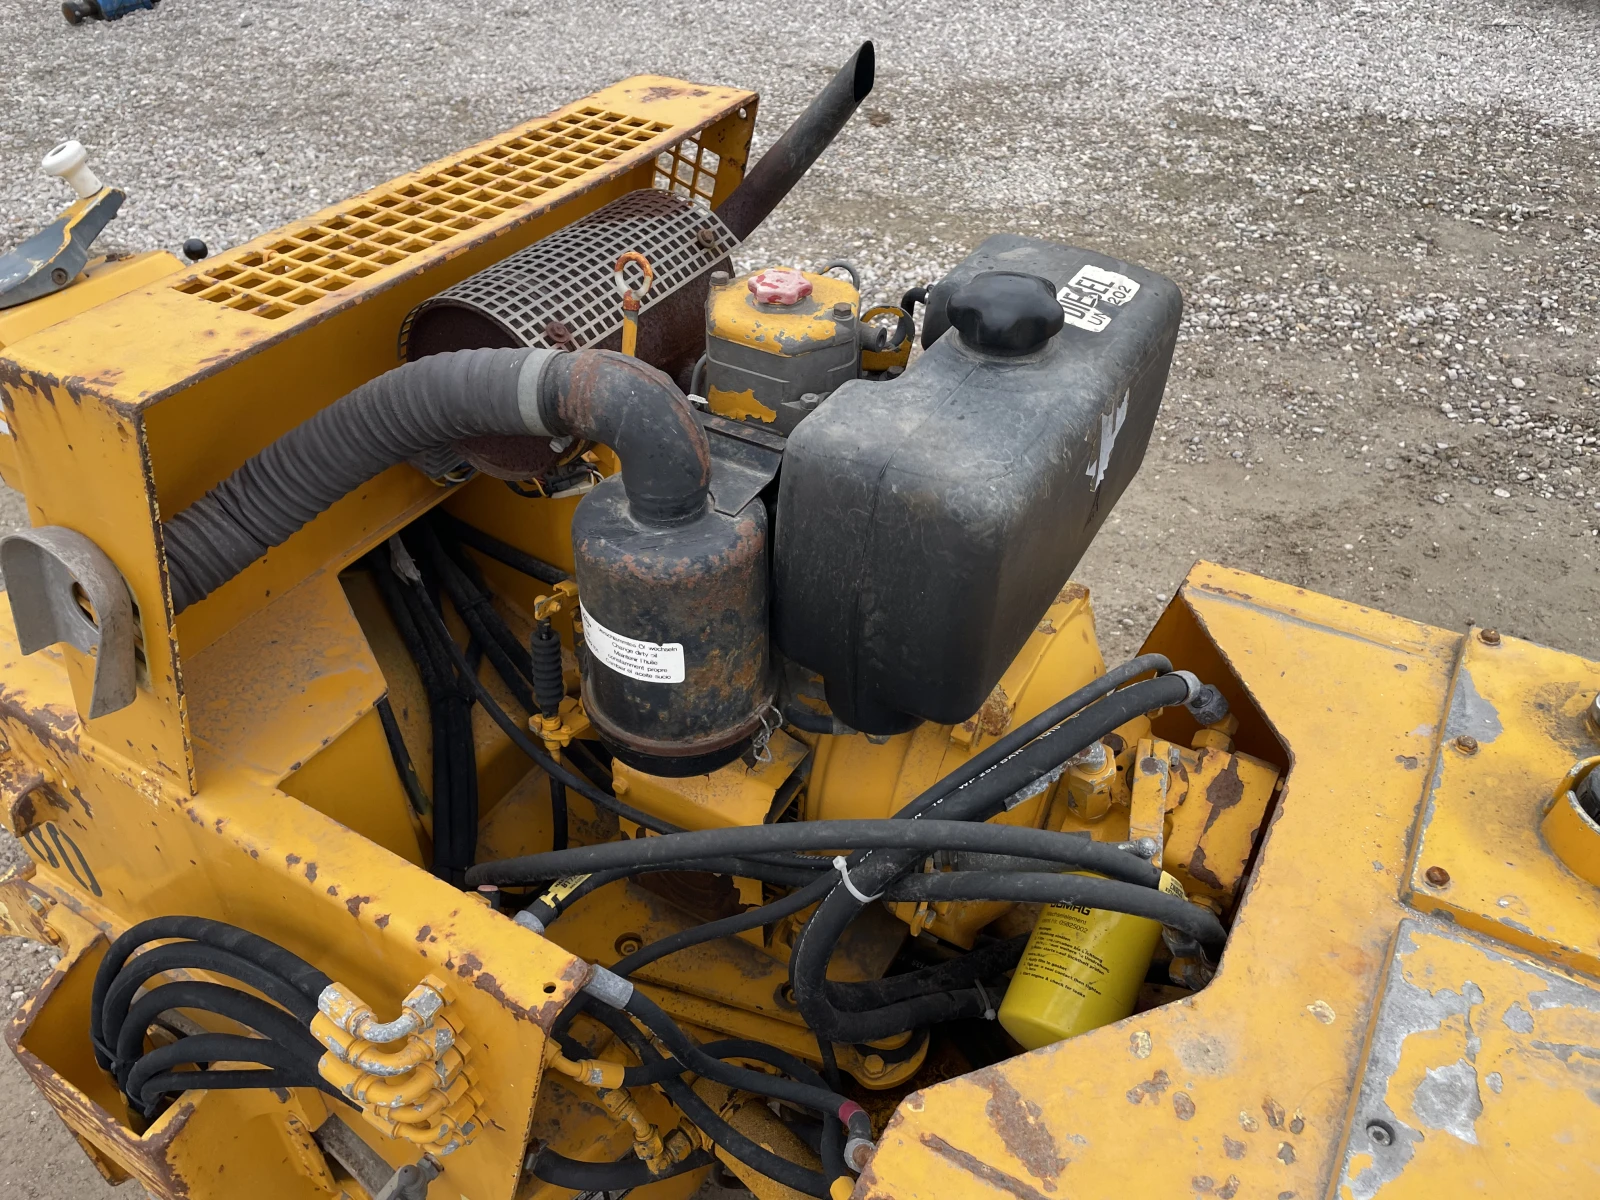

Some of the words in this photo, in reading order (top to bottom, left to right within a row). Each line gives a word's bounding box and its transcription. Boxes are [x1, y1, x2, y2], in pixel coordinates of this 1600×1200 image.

[1107, 285, 1132, 305] 202
[611, 641, 634, 654] Change
[634, 650, 649, 658] dirty
[1000, 748, 1024, 765] BAR
